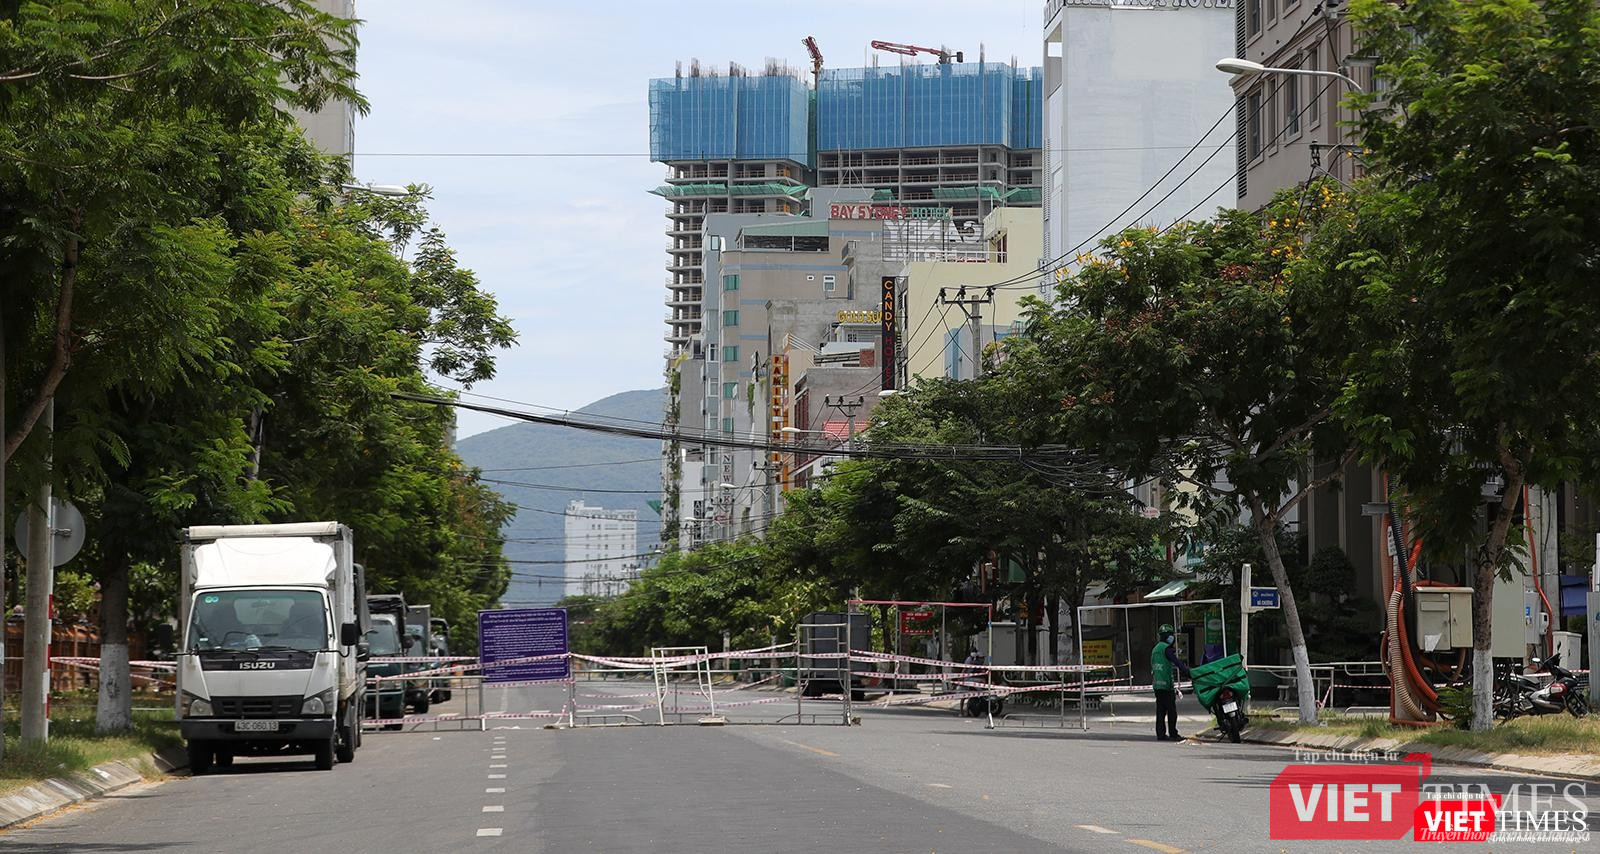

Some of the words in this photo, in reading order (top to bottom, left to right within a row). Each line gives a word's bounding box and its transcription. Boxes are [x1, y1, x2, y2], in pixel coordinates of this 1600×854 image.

[831, 205, 854, 219] BAY
[838, 309, 865, 323] GOLD
[884, 280, 893, 331] CANDY
[884, 337, 893, 388] HOTEL
[772, 356, 781, 416] FAMILY
[723, 454, 731, 482] NEW
[239, 661, 276, 670] ISUZU
